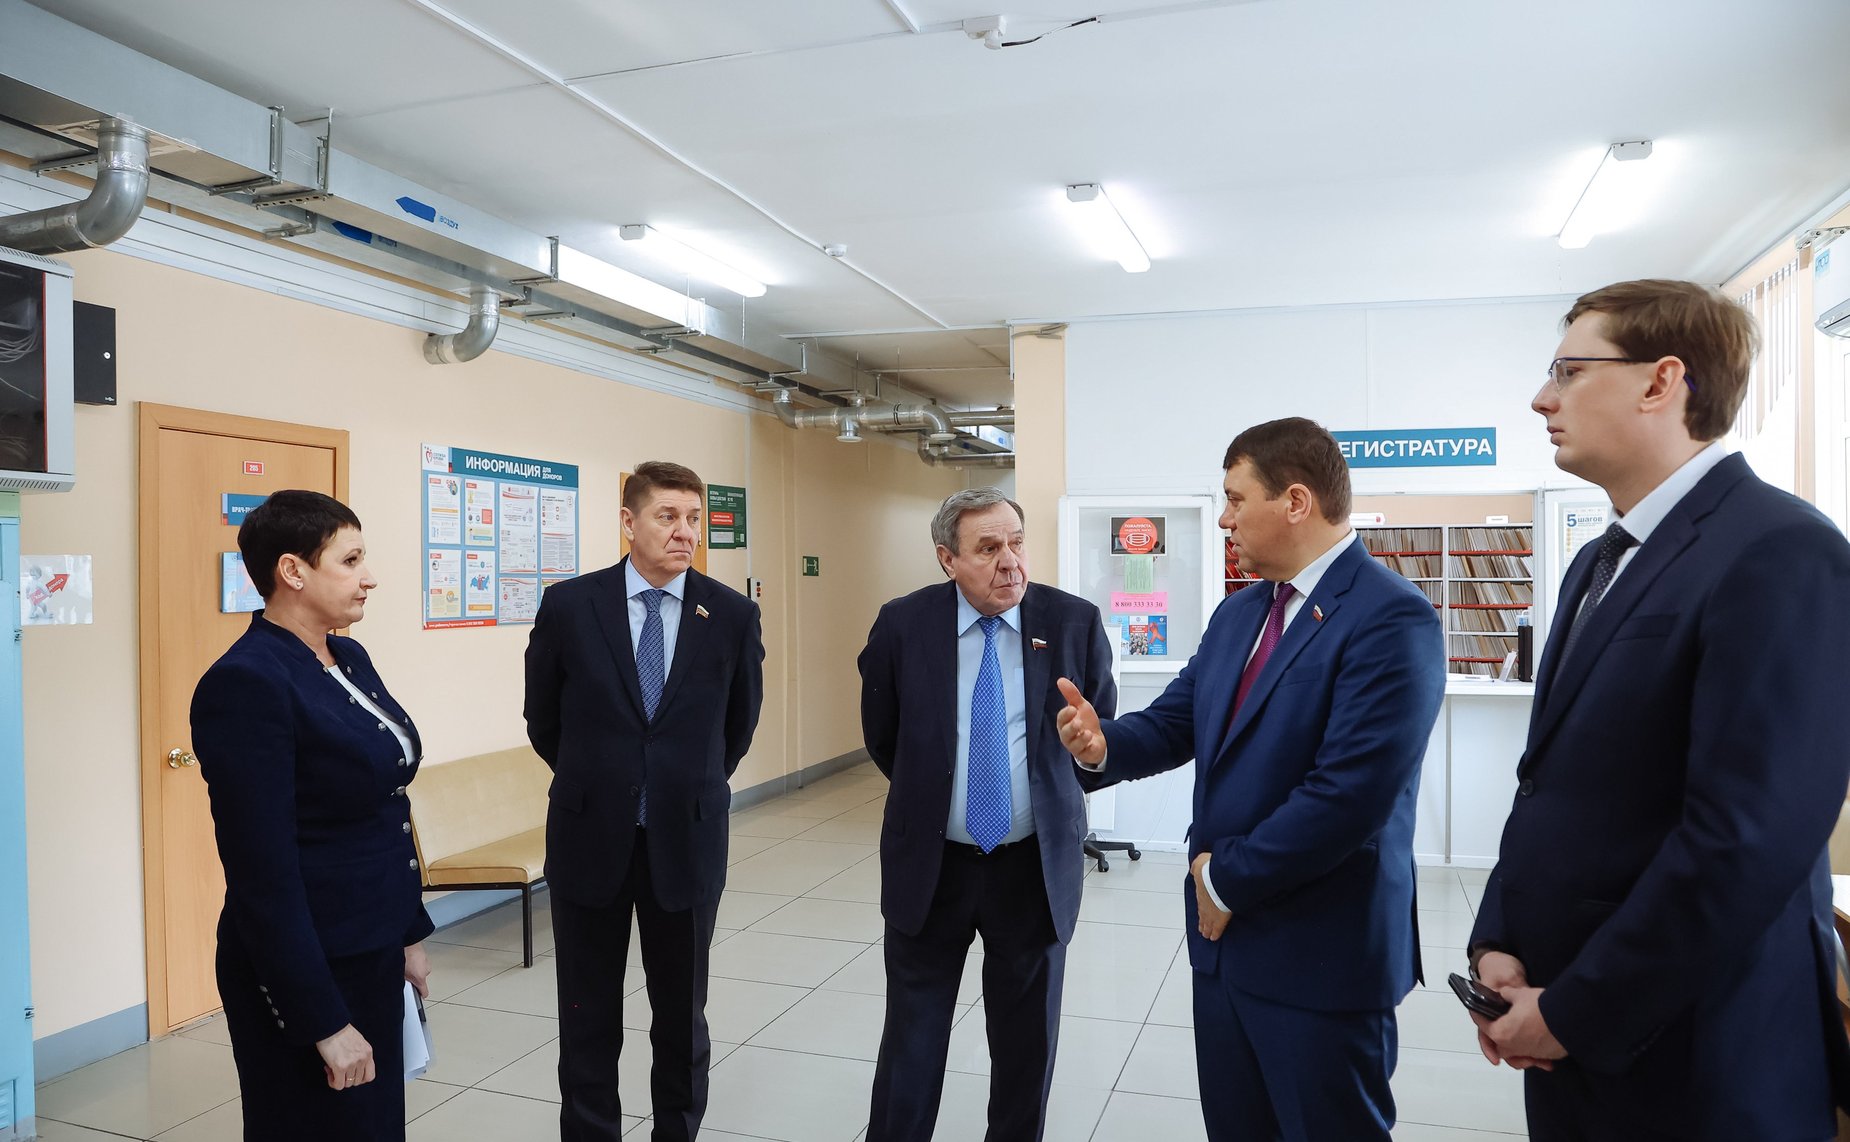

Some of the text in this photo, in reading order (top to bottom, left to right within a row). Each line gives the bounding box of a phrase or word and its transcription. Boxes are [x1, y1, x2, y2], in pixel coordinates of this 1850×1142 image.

[1338, 437, 1493, 459] ЕГИСТРАТУРА
[465, 455, 541, 478] ИНФОРМАЦИЯ
[542, 473, 563, 481] ДОНОРОВ
[1567, 513, 1603, 528] 5 шагов
